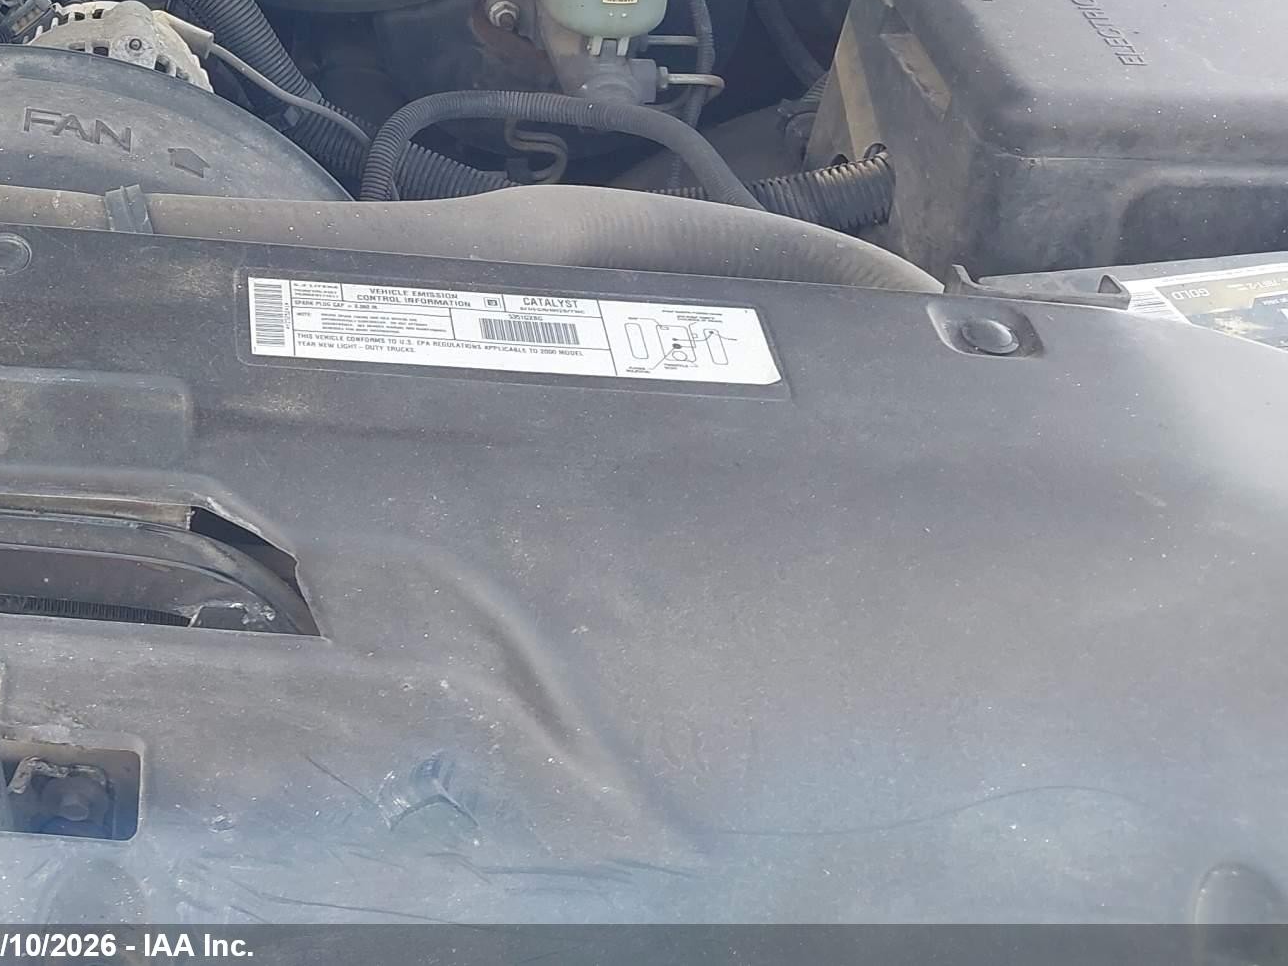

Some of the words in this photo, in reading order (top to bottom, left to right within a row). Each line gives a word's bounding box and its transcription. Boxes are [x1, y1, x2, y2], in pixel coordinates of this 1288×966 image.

[24, 106, 133, 152] FAN
[369, 288, 408, 297] VEHICLE
[411, 290, 458, 299] EMISSION
[1171, 287, 1210, 300] GOLD
[357, 294, 402, 303] CONTROL
[405, 297, 471, 307] INFORMATION
[523, 297, 578, 308] CATALYST
[315, 334, 344, 342] VEHICLE
[346, 336, 385, 344] CONFORMS
[365, 344, 383, 352] DUTY
